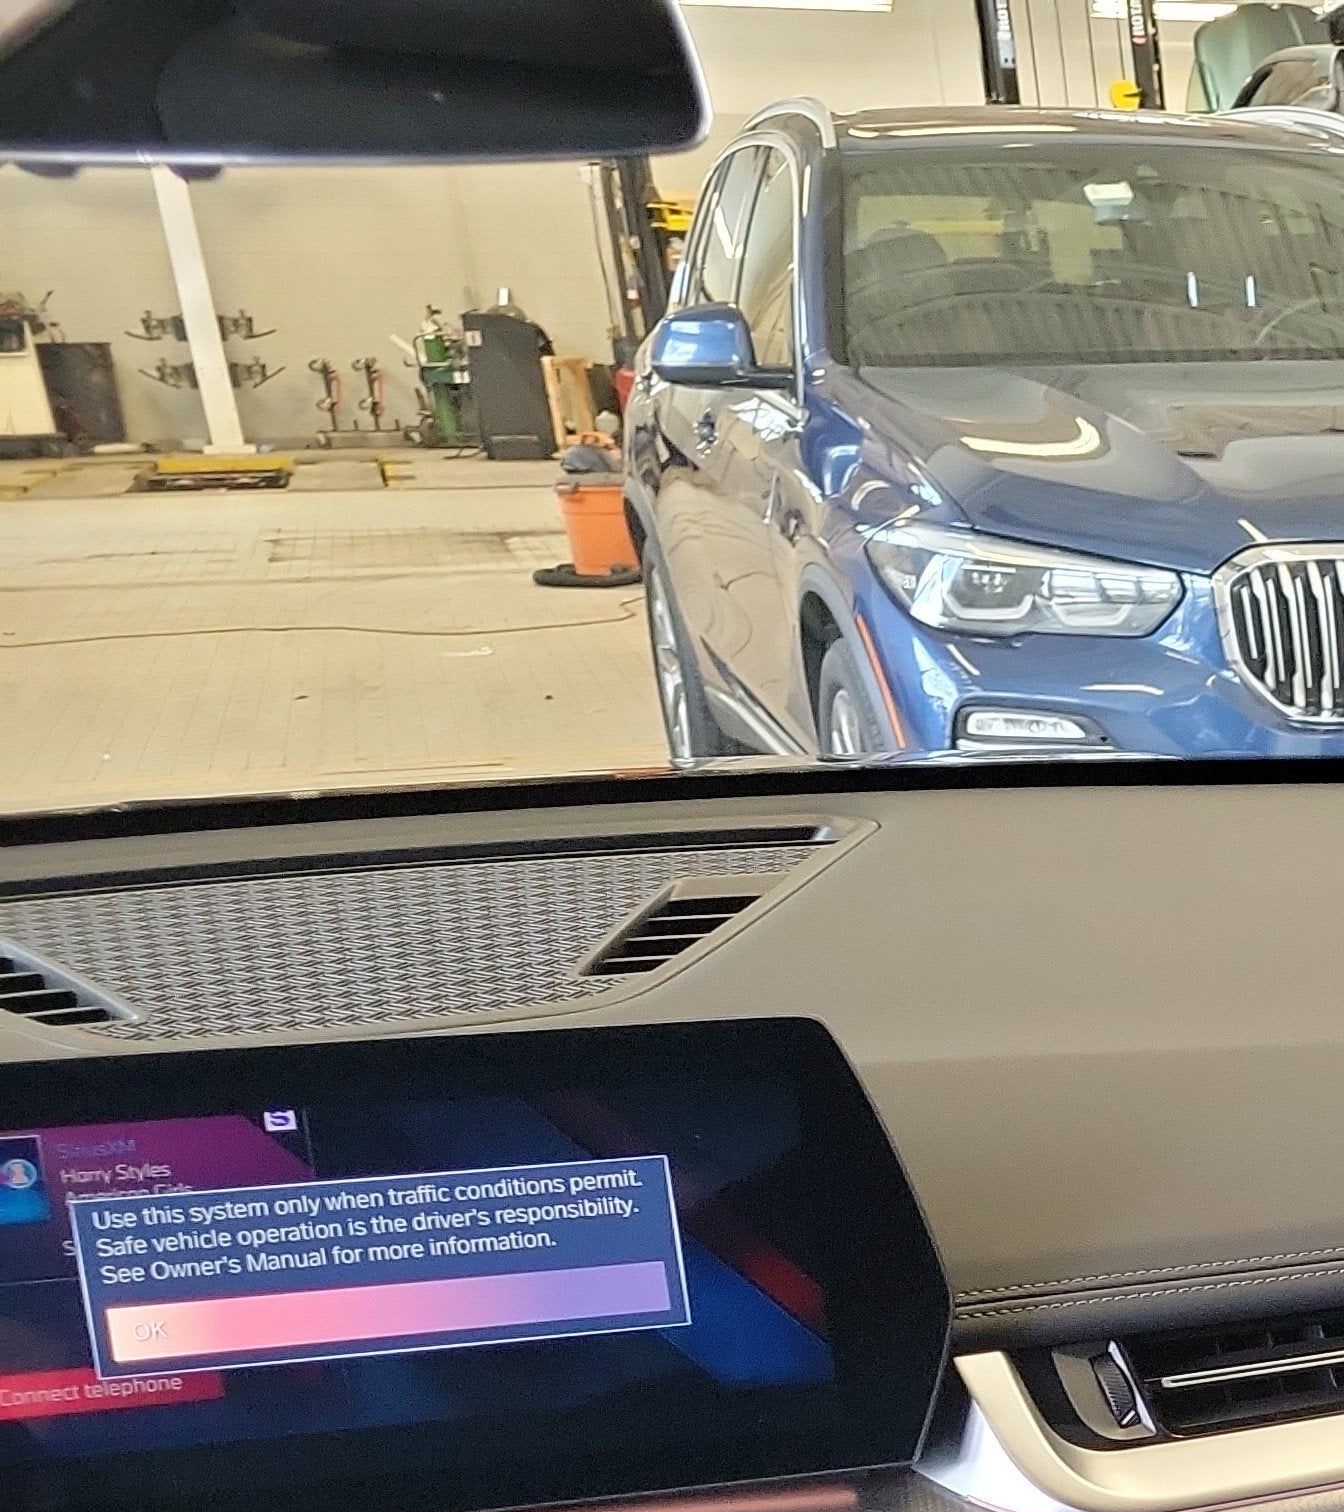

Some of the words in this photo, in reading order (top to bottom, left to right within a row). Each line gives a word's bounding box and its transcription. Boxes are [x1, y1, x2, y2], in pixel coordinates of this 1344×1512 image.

[60, 1168, 112, 1185] Harry
[115, 1162, 171, 1182] Styles
[92, 1211, 137, 1230] Use
[142, 1205, 185, 1226] this
[189, 1199, 269, 1225] system
[273, 1195, 321, 1216] only
[323, 1189, 384, 1211] when
[388, 1184, 450, 1208] traffic
[454, 1177, 566, 1201] conditions
[569, 1168, 643, 1195] permit.
[96, 1235, 148, 1258] Safe
[150, 1227, 232, 1253] vehicle
[236, 1221, 343, 1247] operation
[347, 1218, 367, 1237] is
[371, 1213, 407, 1235] the
[411, 1208, 491, 1231] driver's
[495, 1196, 640, 1228] responsibility.
[101, 1265, 146, 1285] See
[150, 1256, 242, 1280] Owner's
[247, 1248, 327, 1272] Manual
[331, 1245, 363, 1266] for
[368, 1241, 425, 1262] more
[428, 1230, 557, 1256] information.
[132, 1319, 169, 1342] OK
[83, 1376, 183, 1400] telephone
